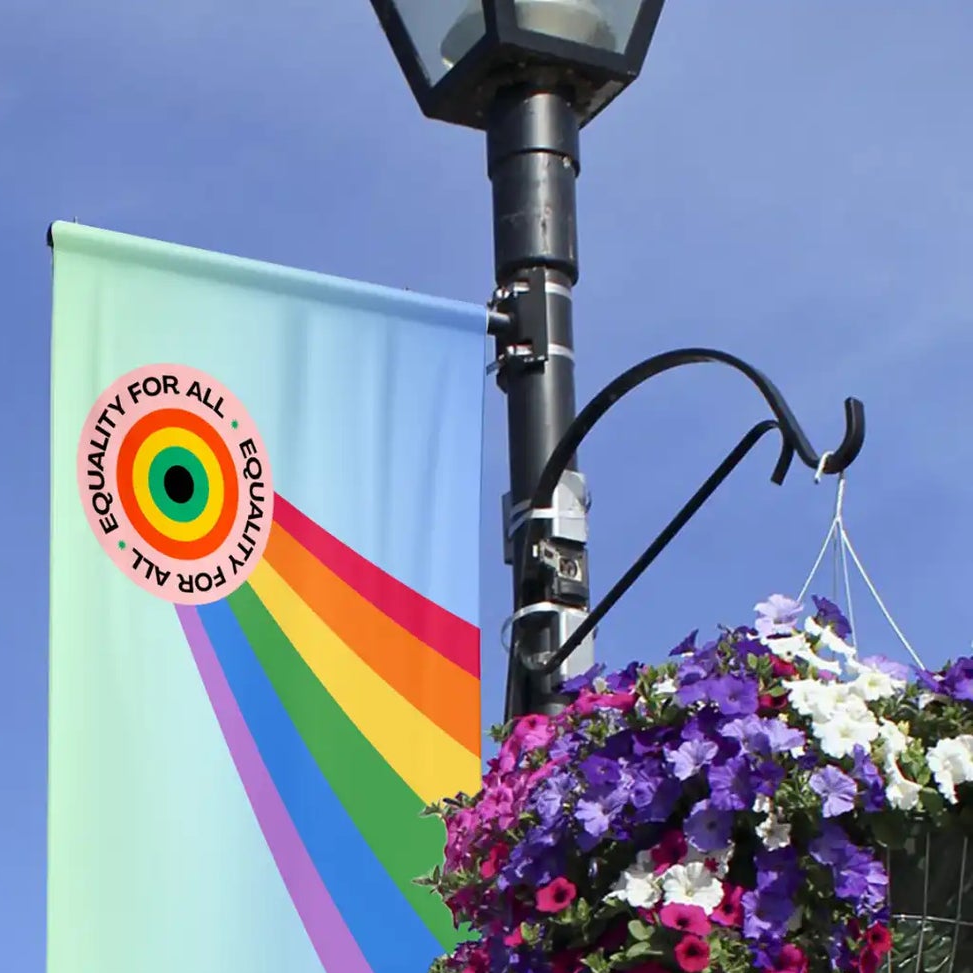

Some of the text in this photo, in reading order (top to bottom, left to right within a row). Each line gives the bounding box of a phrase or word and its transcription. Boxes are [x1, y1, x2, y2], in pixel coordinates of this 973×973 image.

[87, 375, 224, 534] EQUALITY FOR ALL
[132, 438, 265, 593] EQUALITY FOR ALL
